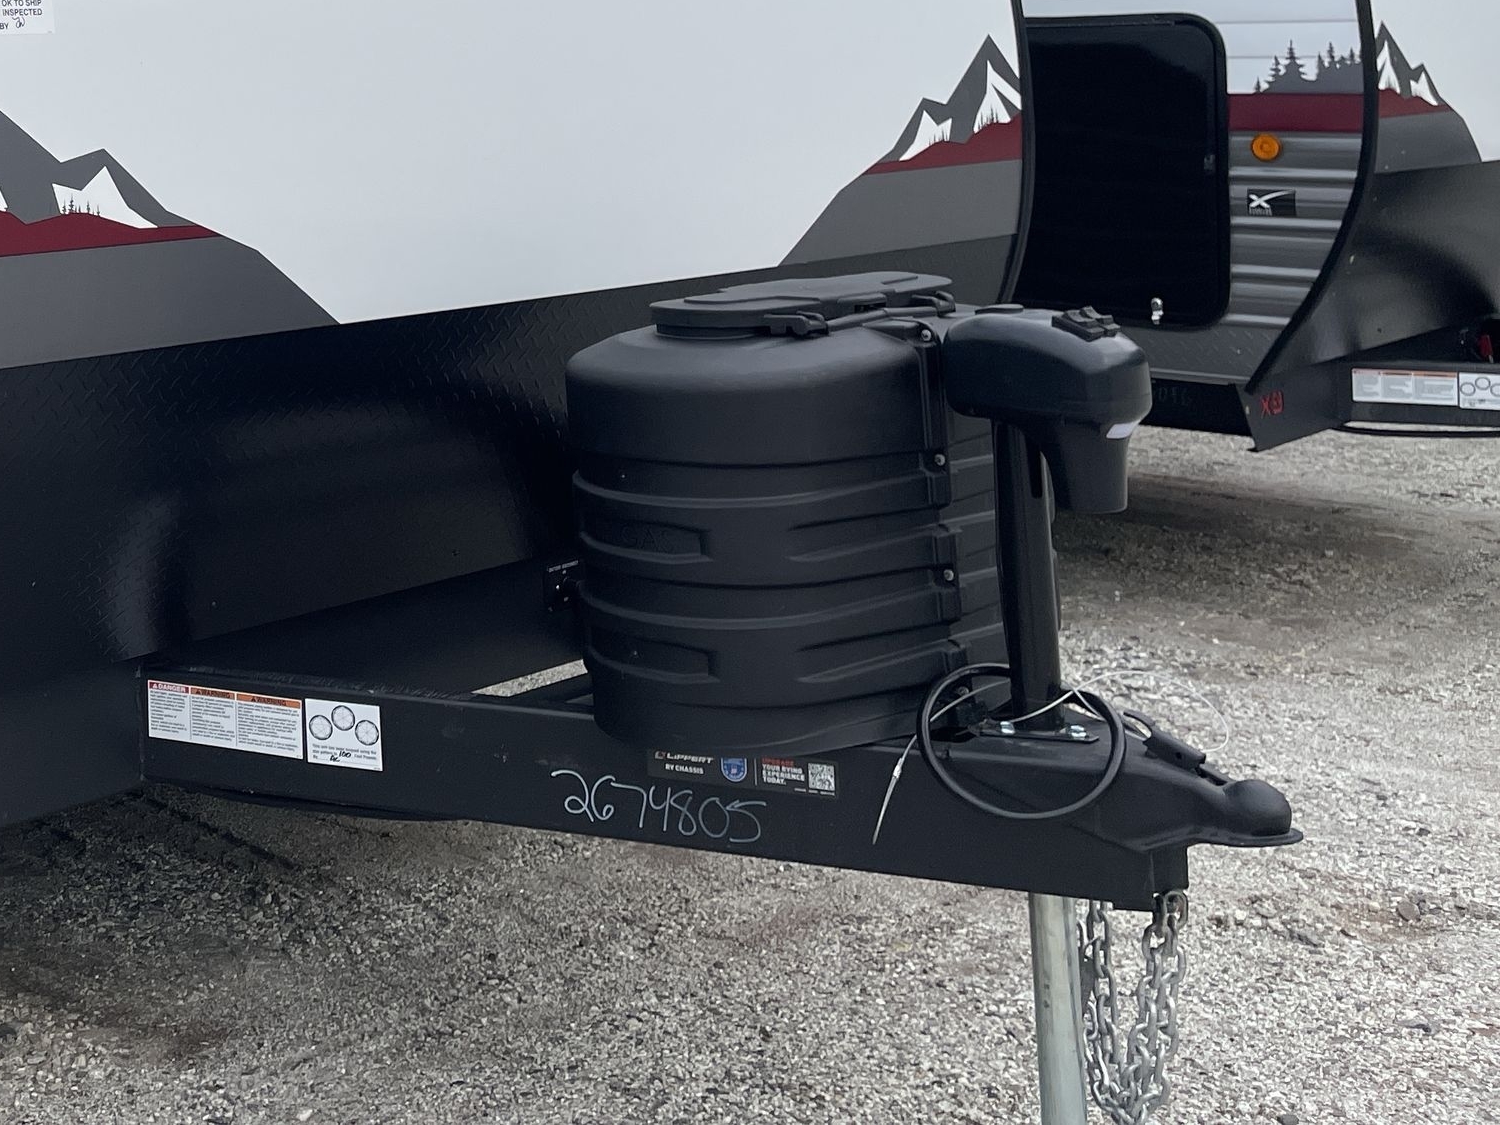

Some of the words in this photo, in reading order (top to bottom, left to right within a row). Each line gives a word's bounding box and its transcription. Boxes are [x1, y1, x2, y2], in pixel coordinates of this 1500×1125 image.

[2, 8, 43, 17] INSPECTED
[0, 22, 9, 30] BY
[157, 683, 186, 693] DANGER
[201, 689, 231, 699] WARNING
[256, 697, 287, 707] WARNING
[666, 752, 714, 764] LIPPERT
[665, 763, 675, 771] RV
[675, 764, 704, 774] CHASSIS
[762, 763, 781, 772] YOUR
[762, 770, 805, 781] EXPERIENCE
[763, 777, 787, 785] TODAY.
[551, 769, 767, 843] 2674805
